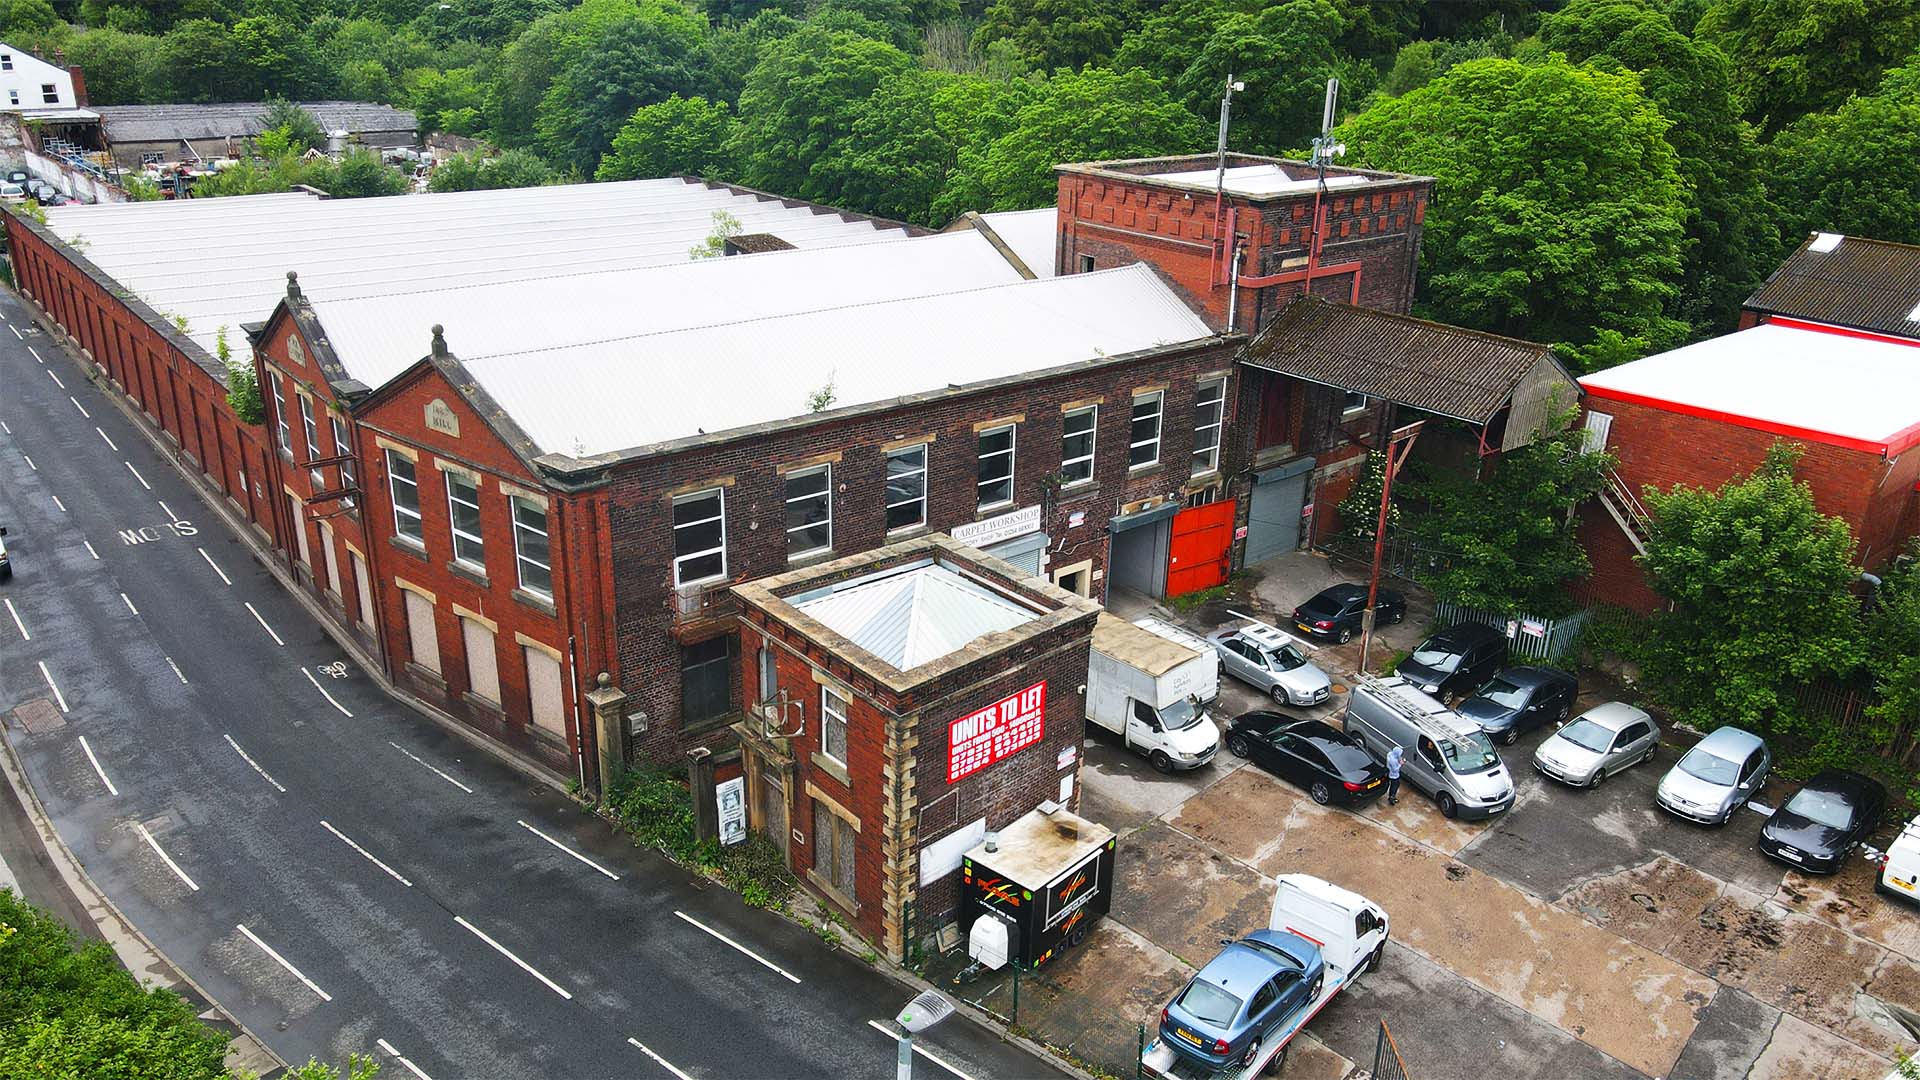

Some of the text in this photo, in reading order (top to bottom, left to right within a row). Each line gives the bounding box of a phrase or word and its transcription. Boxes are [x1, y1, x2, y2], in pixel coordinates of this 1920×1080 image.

[118, 520, 198, 546] SLOW
[953, 509, 1038, 540] CARPET WORKSHOP
[951, 685, 1043, 746] UNITS TO LET
[952, 740, 973, 756] UNITS
[972, 731, 991, 746] FROM
